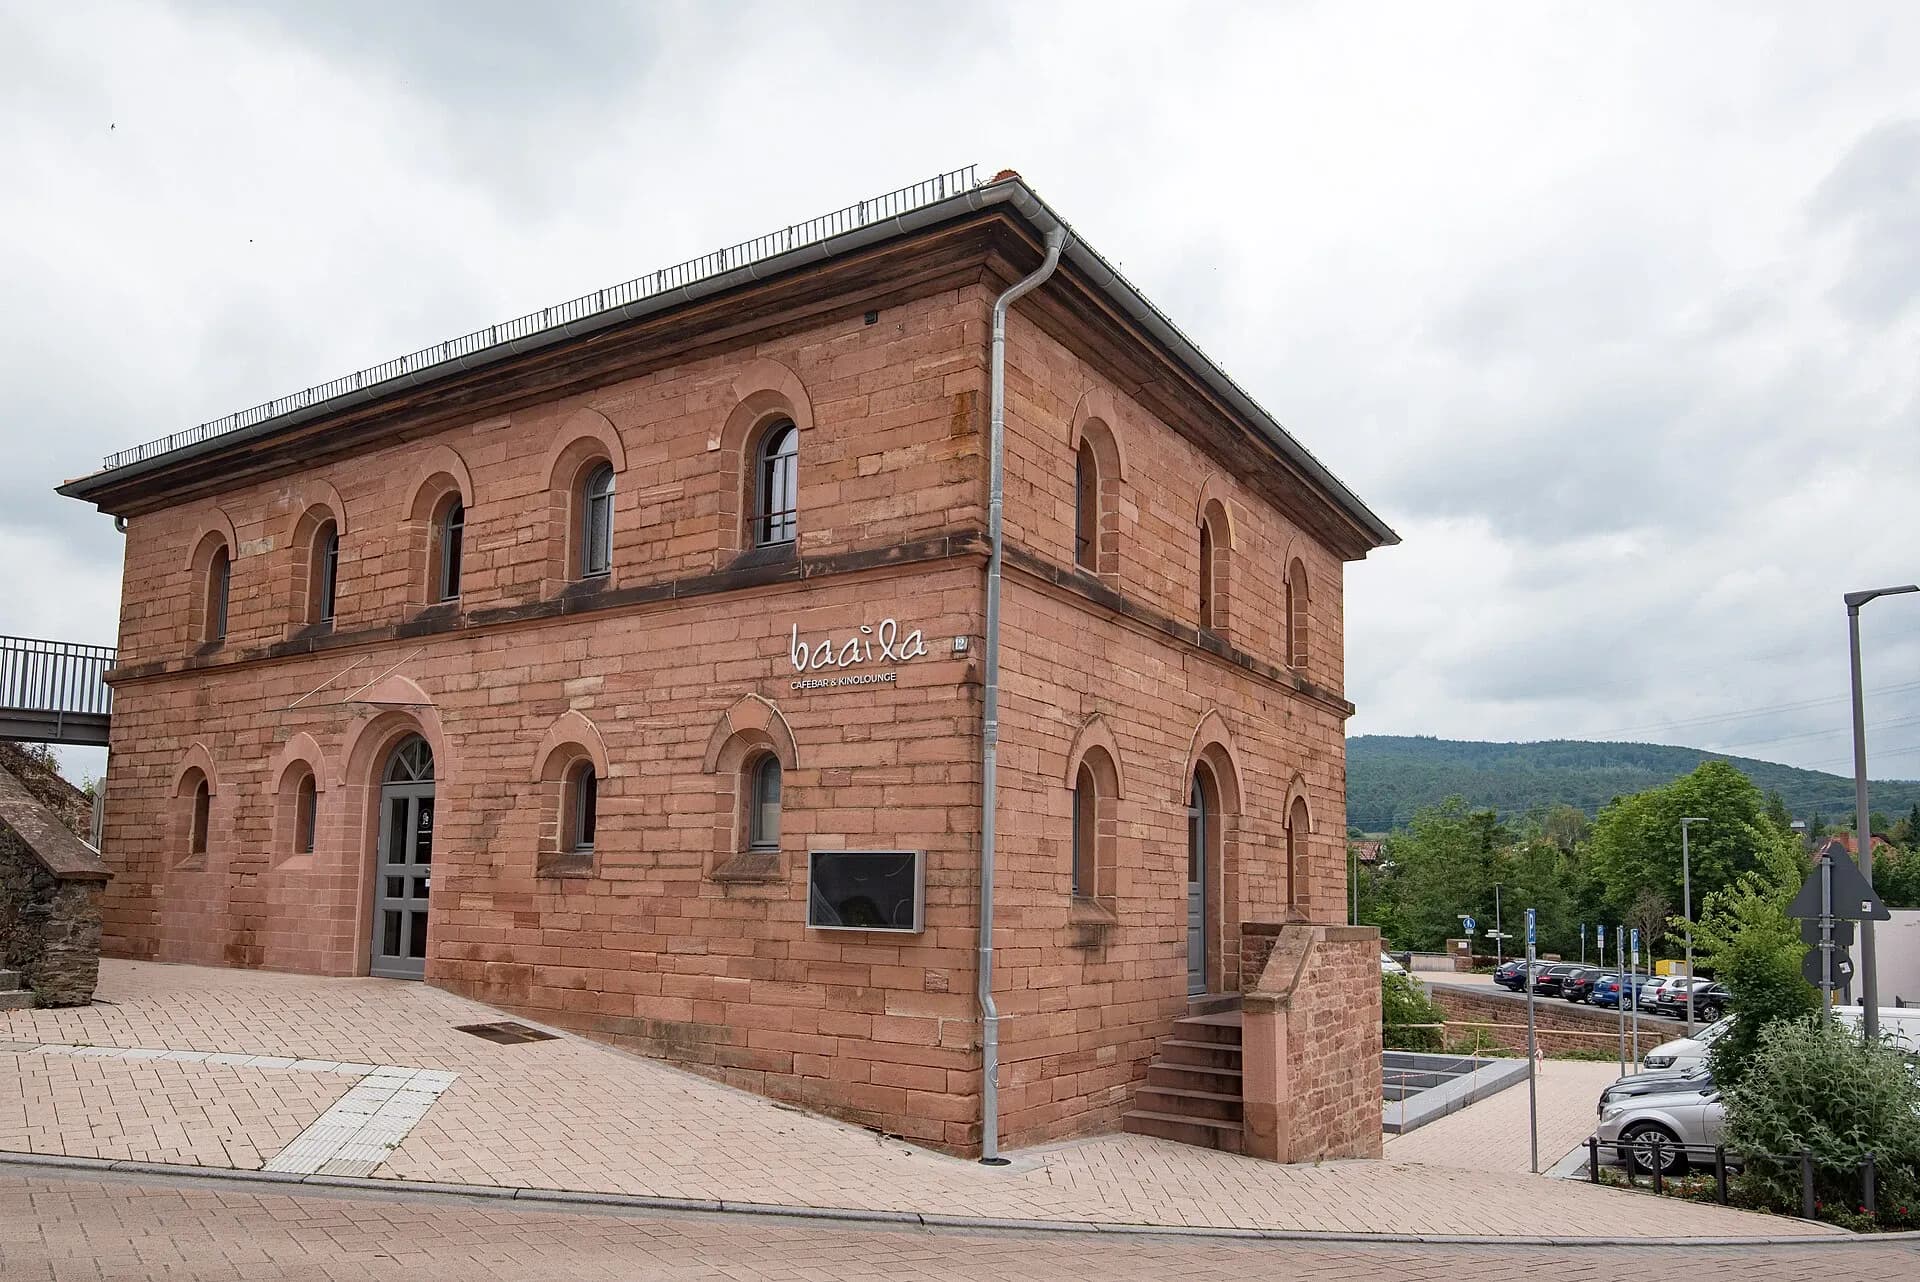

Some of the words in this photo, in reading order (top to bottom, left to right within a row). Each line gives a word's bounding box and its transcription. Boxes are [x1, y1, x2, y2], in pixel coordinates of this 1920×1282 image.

[791, 618, 928, 671] baaila
[790, 678, 829, 690] CAFEBAR
[830, 678, 838, 687] &
[838, 672, 897, 686] KINOLOUNGE
[1528, 912, 1535, 939] P
